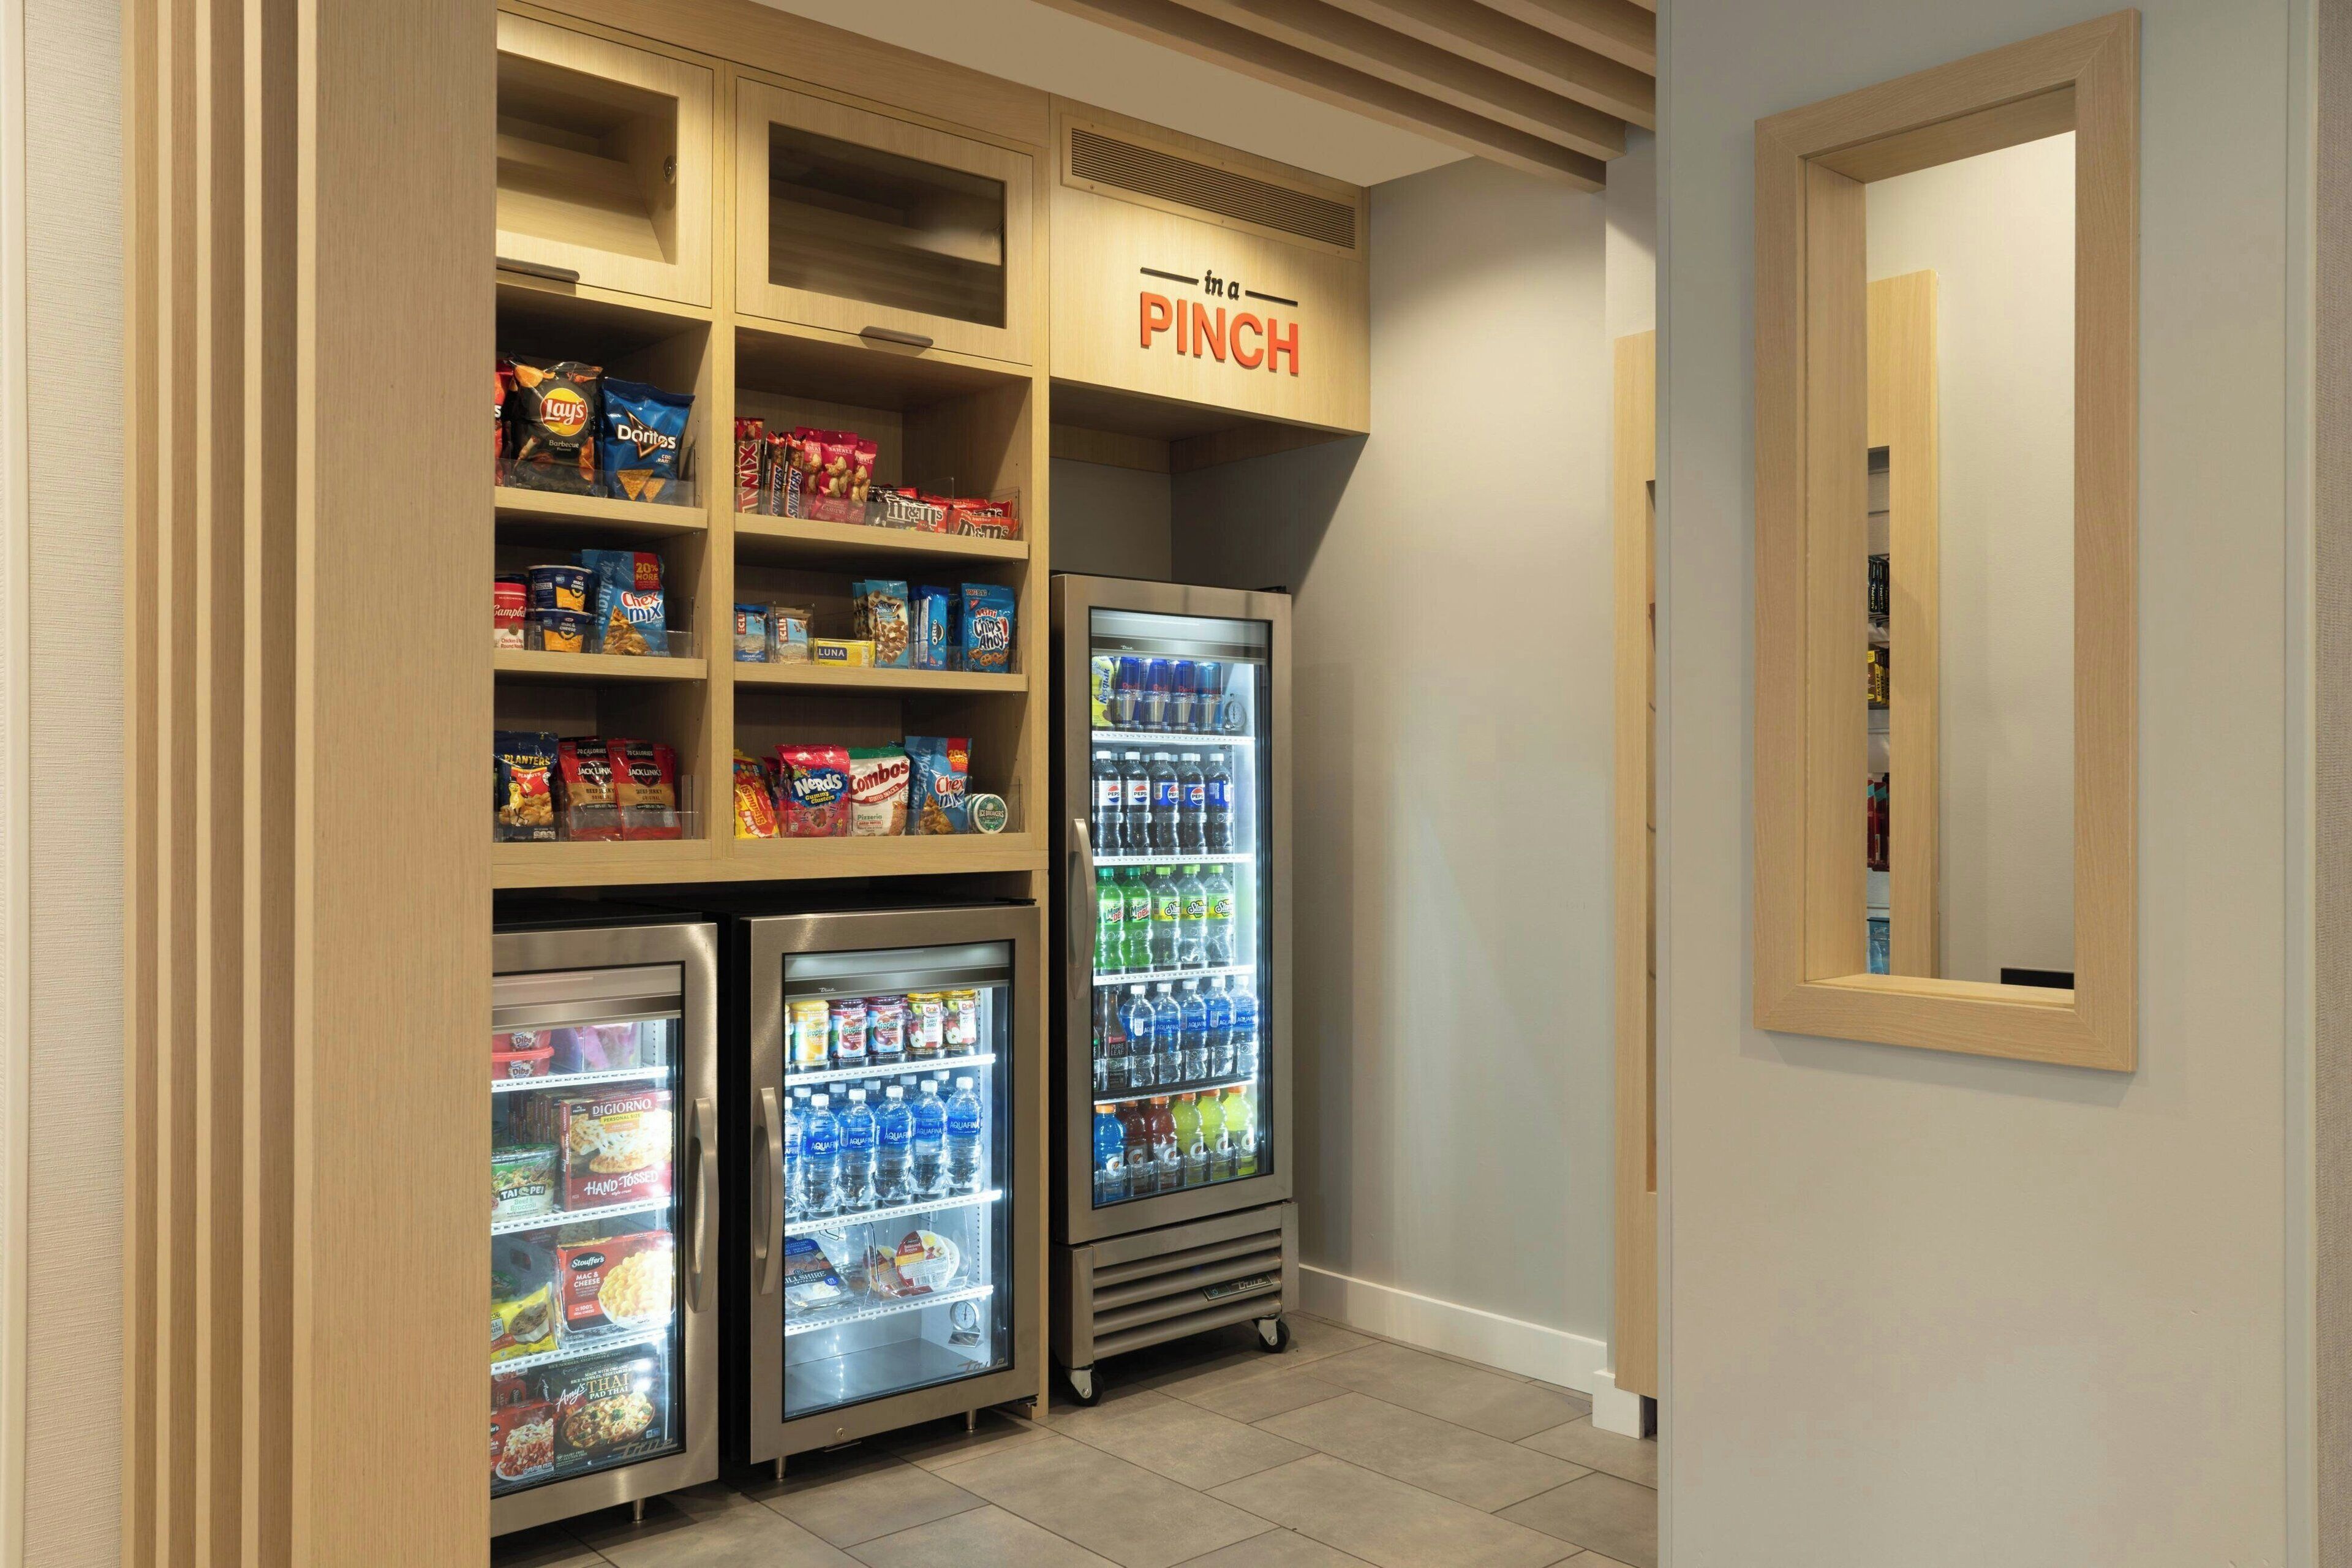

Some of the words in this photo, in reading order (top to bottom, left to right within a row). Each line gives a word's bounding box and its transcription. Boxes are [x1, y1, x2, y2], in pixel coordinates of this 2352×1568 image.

[1205, 270, 1223, 298] in
[1227, 281, 1240, 300] a
[1140, 291, 1299, 377] PINCH
[545, 399, 584, 426] Lay's
[549, 440, 579, 448] Barbecue
[617, 424, 676, 450] Doritos
[737, 443, 760, 514] TWIX
[788, 470, 802, 518] SNICKERS
[636, 563, 658, 573] 20%
[622, 592, 660, 607] Chex
[630, 603, 663, 622] mix
[975, 608, 997, 618] Mini
[973, 619, 1001, 638] Chips
[818, 648, 845, 657] LUNA
[504, 754, 551, 766] PLANTERS
[850, 762, 909, 795] Combos
[936, 775, 967, 794] Chex
[805, 791, 829, 801] Gummy
[811, 795, 835, 804] Clusters
[513, 1067, 529, 1076] Dibs
[584, 1170, 659, 1196] HAND-TOSSED
[501, 1189, 518, 1199] TAI
[530, 1186, 544, 1194] PEI
[510, 1203, 537, 1212] Broccoli
[571, 1256, 605, 1268] Stouffer's
[574, 1278, 601, 1287] CHEESE
[576, 1273, 592, 1281] MAC
[785, 1271, 826, 1284] ILLSHIRE
[587, 1373, 629, 1393] THAI
[556, 1382, 588, 1412] Amy's
[589, 1391, 605, 1400] PAD
[608, 1385, 628, 1395] THAI
